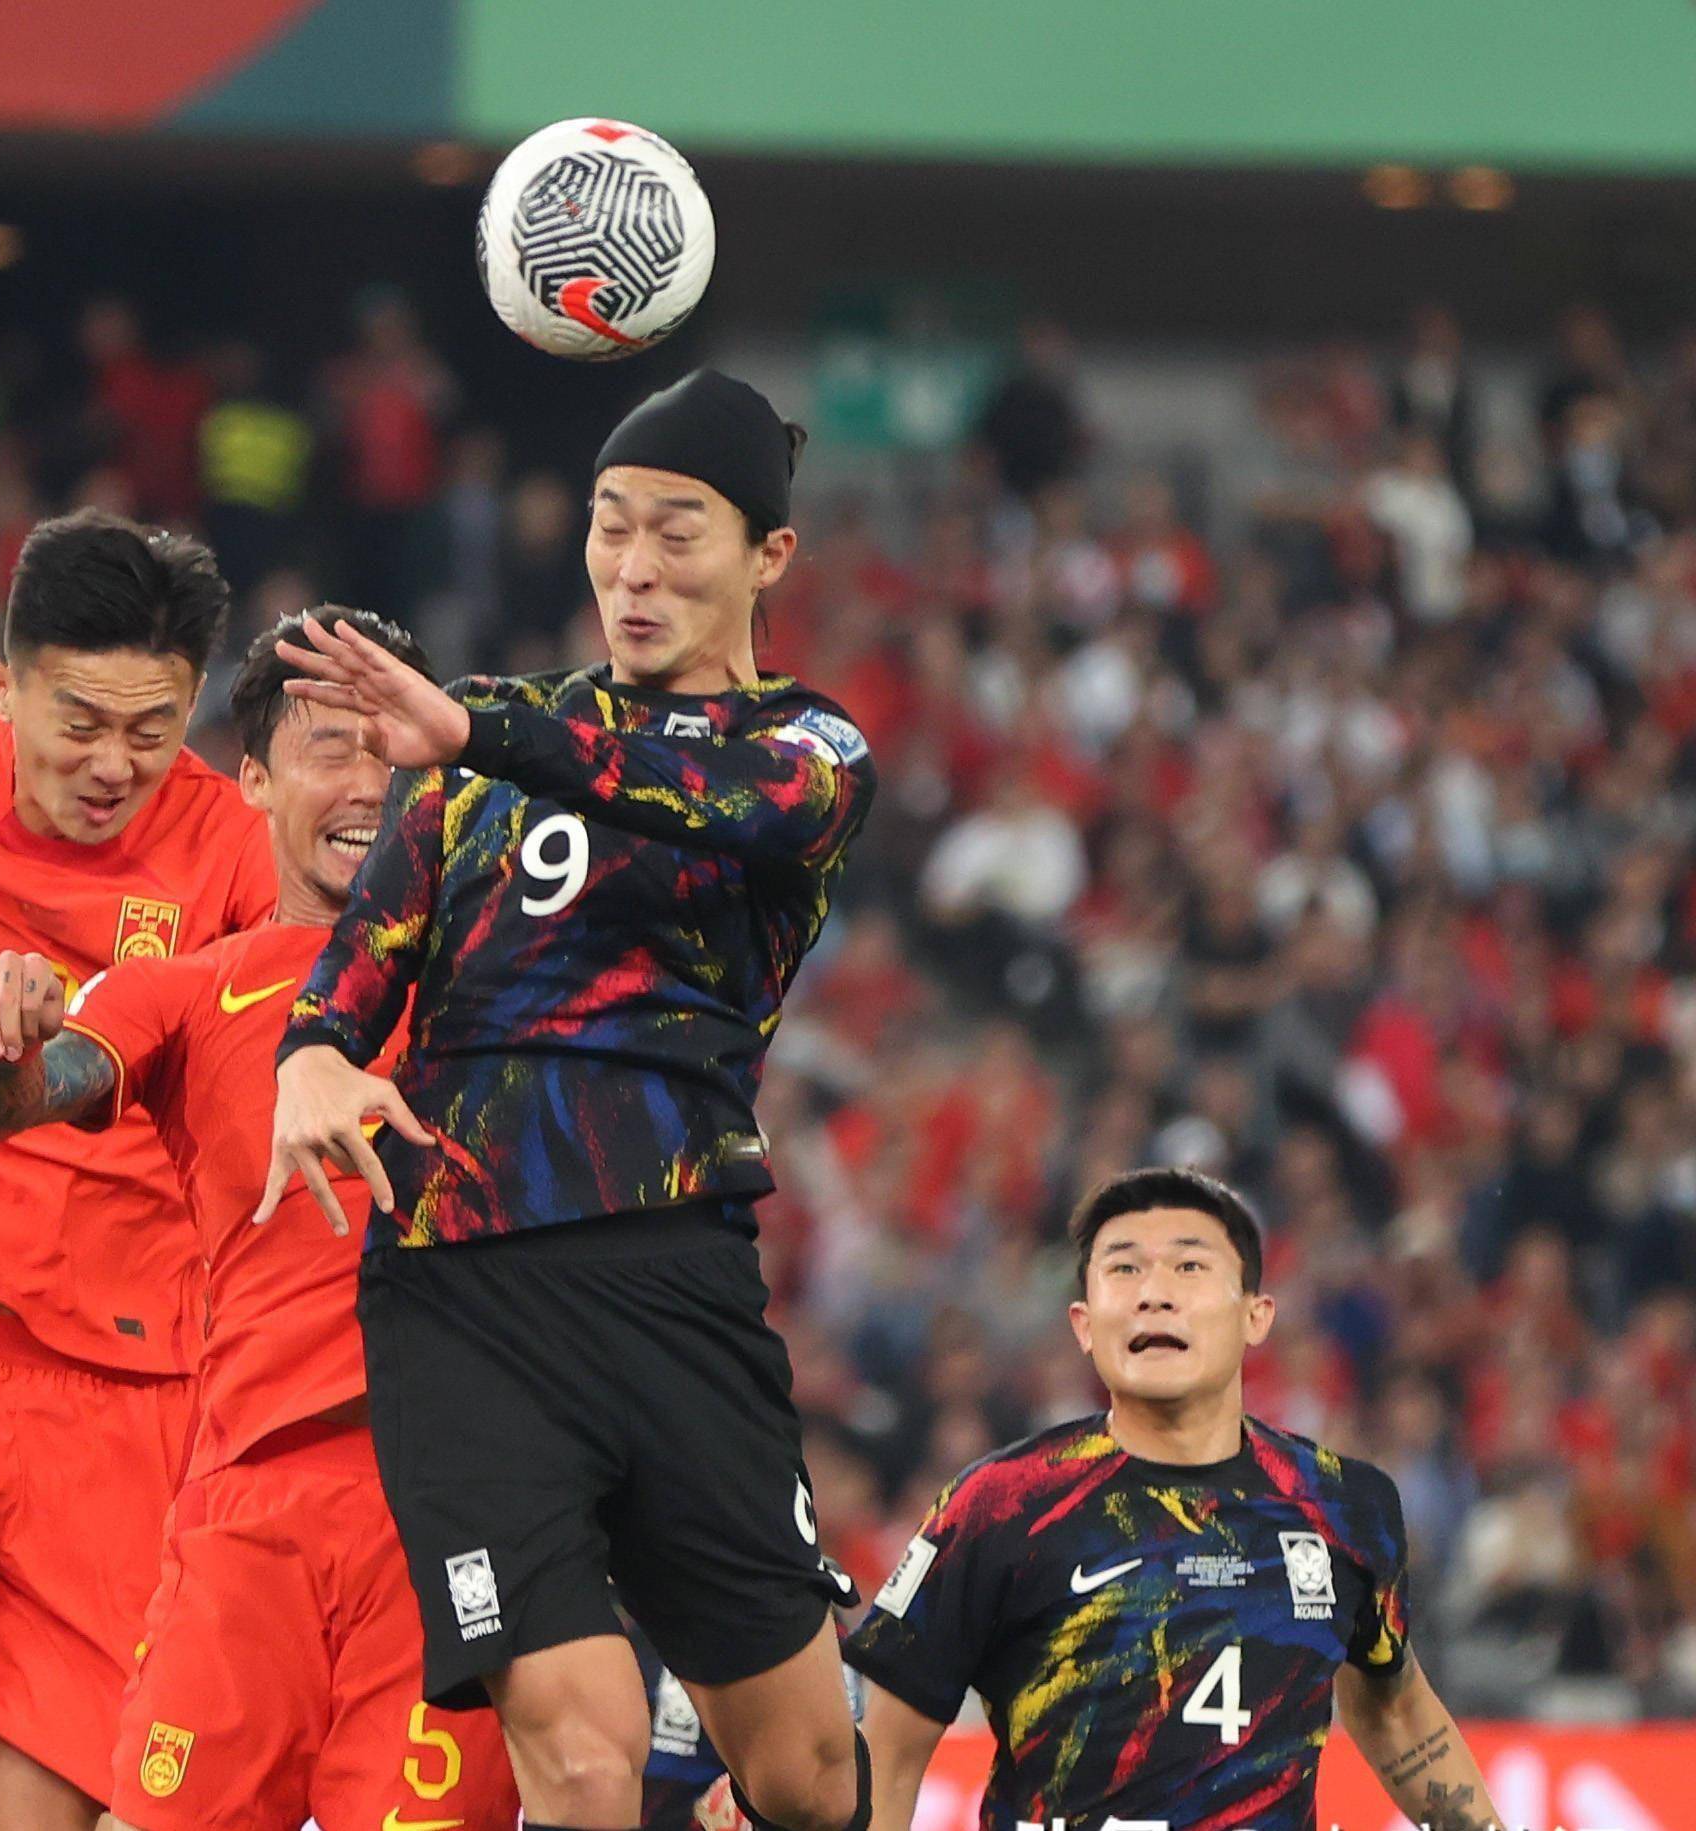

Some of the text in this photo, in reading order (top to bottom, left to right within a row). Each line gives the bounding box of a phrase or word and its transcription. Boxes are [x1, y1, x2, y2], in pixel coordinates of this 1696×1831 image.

[520, 813, 590, 917] 9
[460, 1617, 503, 1643] KOREA
[1294, 1603, 1334, 1620] KOREA
[1182, 1645, 1252, 1745] 4
[403, 1700, 462, 1800] 5
